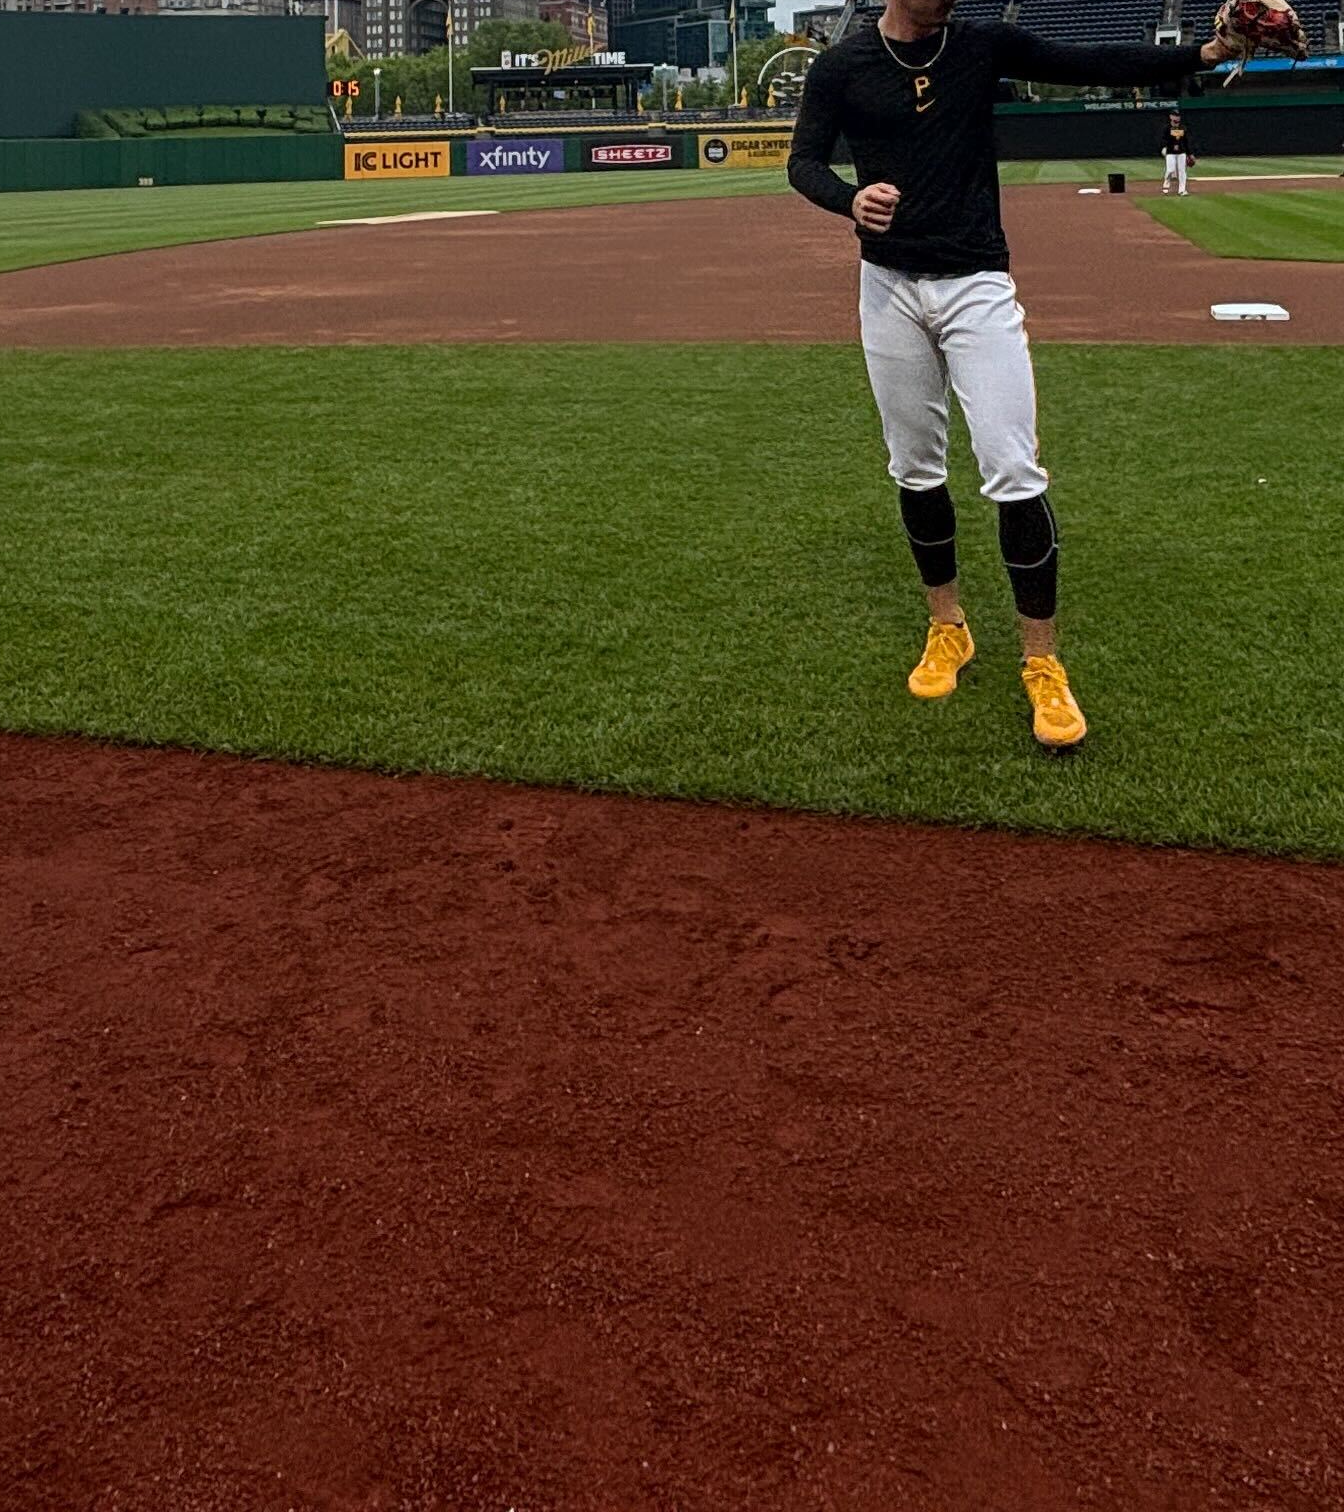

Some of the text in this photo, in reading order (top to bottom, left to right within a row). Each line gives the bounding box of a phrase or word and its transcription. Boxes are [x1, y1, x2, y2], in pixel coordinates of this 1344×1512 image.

[593, 52, 626, 65] TIME
[333, 80, 360, 97] 0:15
[914, 76, 931, 98] P
[760, 139, 791, 150] SNYDE
[382, 151, 442, 170] LIGHT
[480, 145, 551, 170] xfinity
[597, 147, 666, 161] SHEETZ
